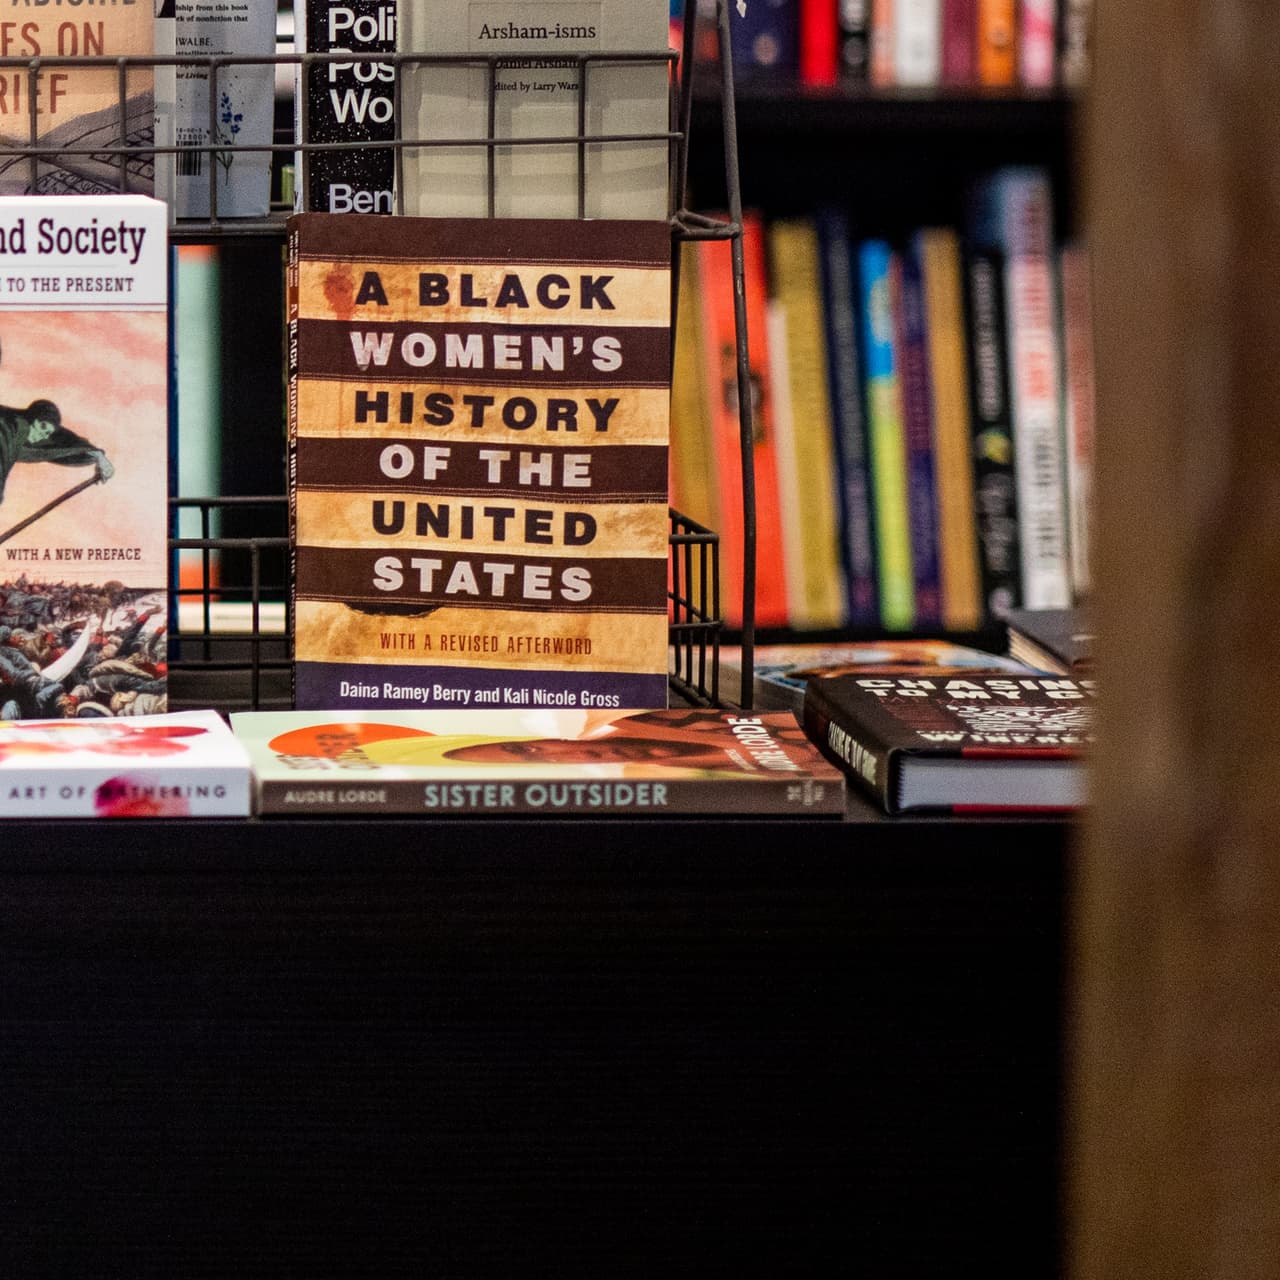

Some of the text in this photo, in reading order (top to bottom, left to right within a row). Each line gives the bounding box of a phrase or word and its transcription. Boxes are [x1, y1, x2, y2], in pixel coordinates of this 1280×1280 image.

[328, 7, 396, 42] Poli
[478, 22, 596, 39] Arsham-isms
[57, 21, 104, 57] ON
[494, 81, 517, 91] dited
[533, 82, 556, 93] Larry
[557, 81, 579, 91] Wars
[329, 184, 392, 214] Ben
[38, 219, 146, 264] Society
[7, 278, 26, 292] TO
[31, 278, 59, 292] THE
[66, 278, 134, 292] PRESENT
[356, 271, 615, 310] A BLACK
[350, 332, 622, 372] WOMEN'S
[354, 391, 620, 432] HISTORY
[379, 444, 592, 487] OF THE
[372, 501, 597, 546] UNITED
[6, 548, 141, 561] WITH A NEW PREFACE
[372, 557, 593, 601] STATES
[380, 632, 592, 654] WITH A REVISED AFTERWORD
[340, 681, 620, 708] Daina Ramey Berry and Kali Nicole Gross
[947, 690, 1022, 699] MY
[8, 786, 47, 800] ART
[60, 786, 87, 800] OF
[98, 785, 228, 800] GATHERING
[284, 790, 386, 803] AUDRE LORDE
[425, 784, 668, 807] SISTER OUTSIDER
